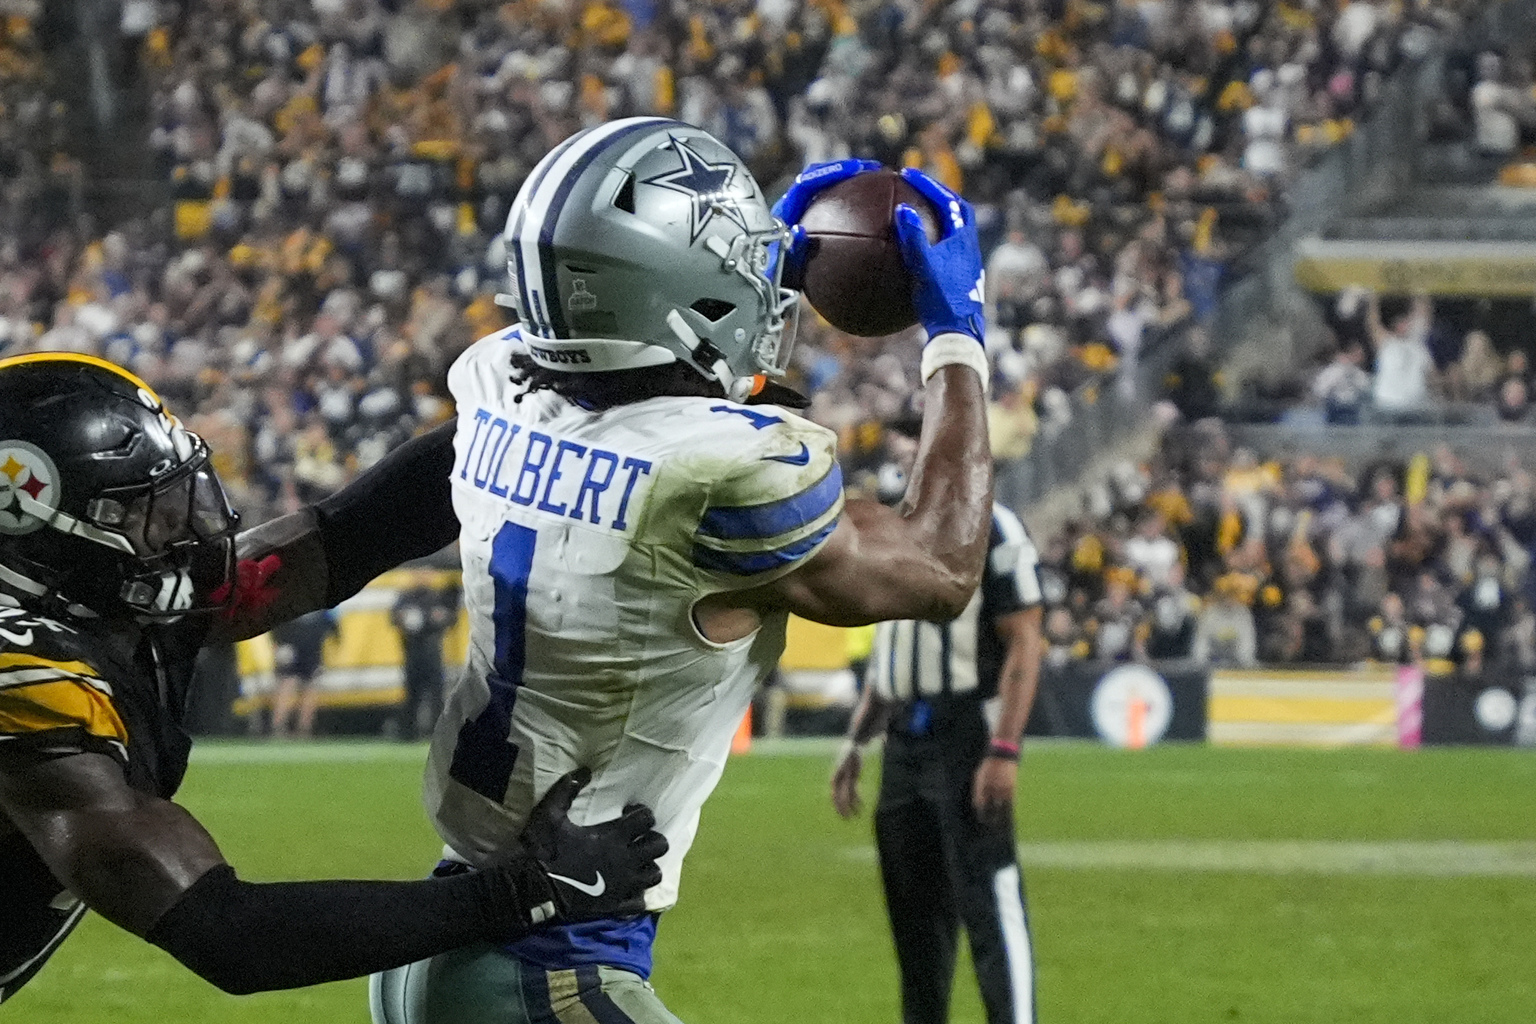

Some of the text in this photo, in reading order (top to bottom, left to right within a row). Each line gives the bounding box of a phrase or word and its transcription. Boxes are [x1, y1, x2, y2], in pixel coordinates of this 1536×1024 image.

[530, 345, 592, 364] OWBOYS
[461, 408, 652, 531] TOLBERT
[449, 519, 538, 805] 1
